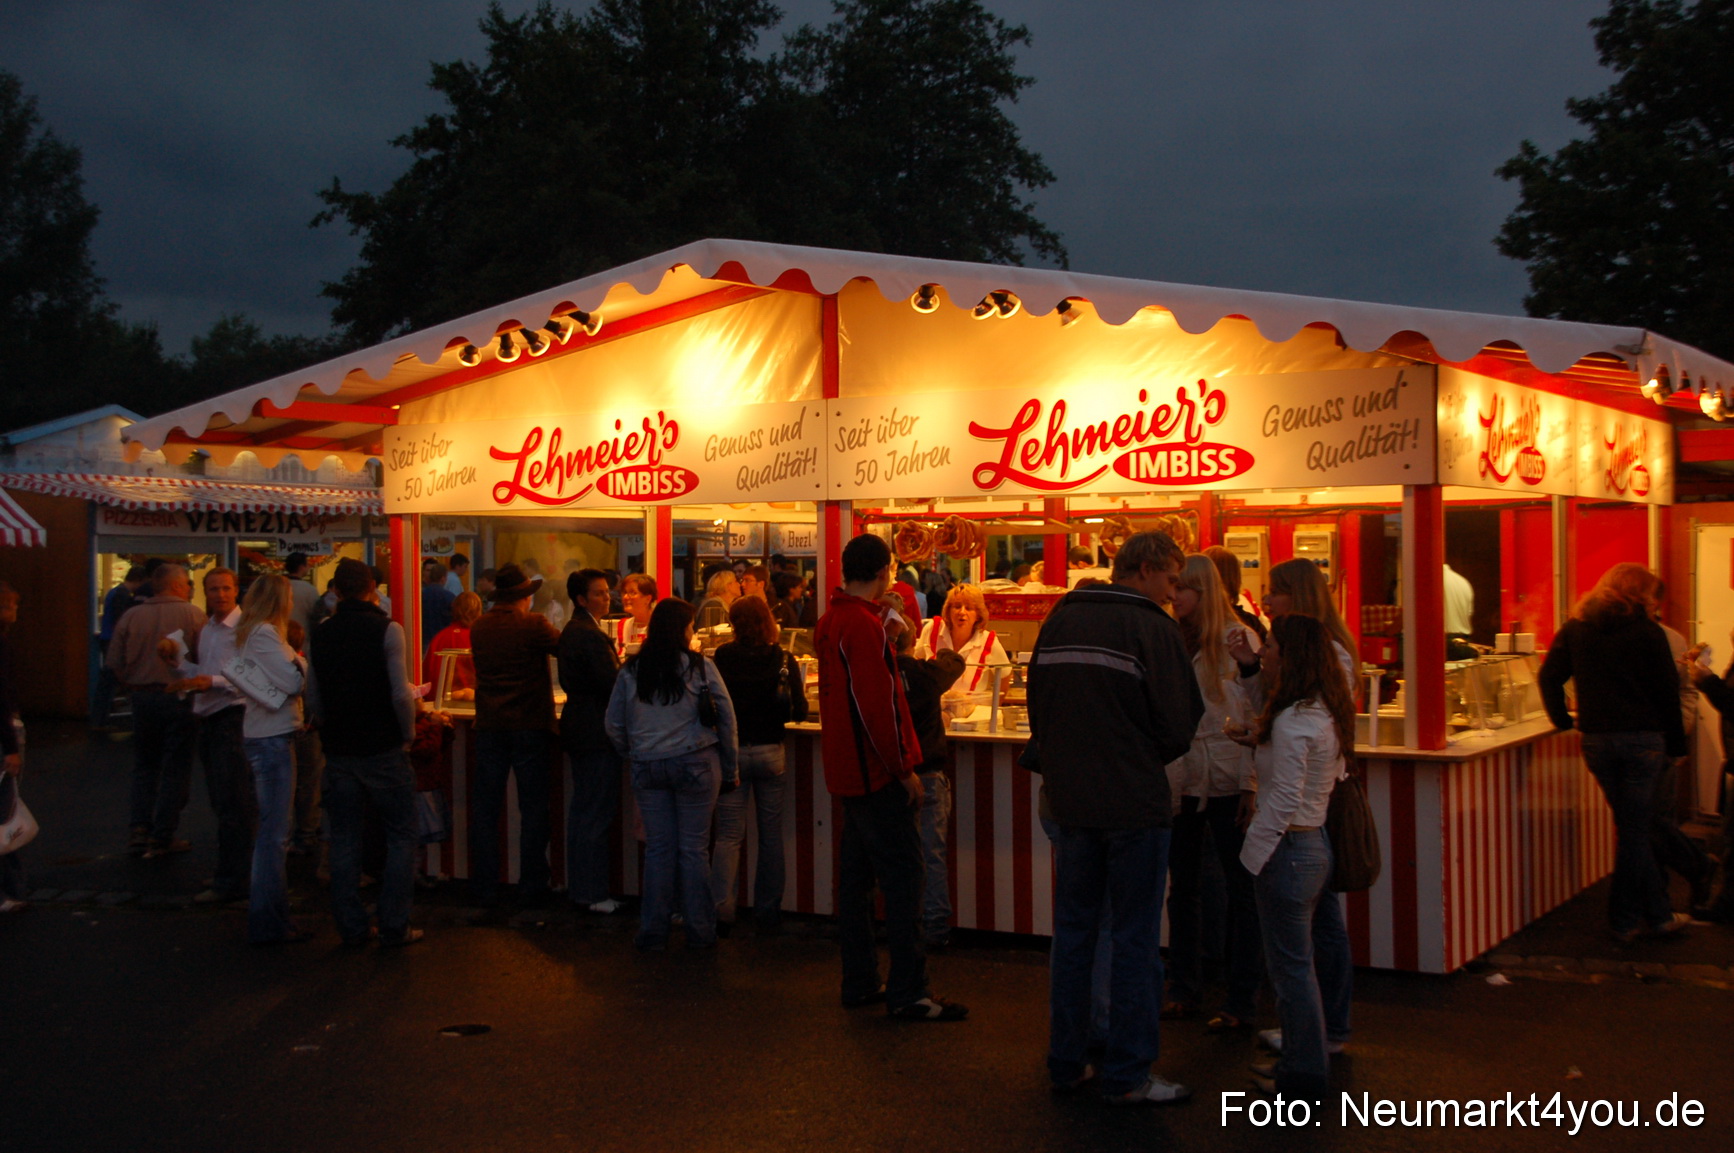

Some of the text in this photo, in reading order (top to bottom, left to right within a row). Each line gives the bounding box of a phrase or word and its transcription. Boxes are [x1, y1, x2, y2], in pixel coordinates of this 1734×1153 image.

[1263, 396, 1343, 438] Genuss
[1354, 371, 1406, 415] und
[389, 432, 454, 471] Seit über
[705, 406, 807, 462] Genuss und
[836, 405, 920, 453] Seit über
[968, 378, 1227, 490] Lehmeier's
[1306, 418, 1419, 471] Qualität!
[404, 461, 477, 500] 50 Jahren
[489, 410, 679, 506] Lehmeier's
[736, 446, 818, 492] Qualität!
[854, 440, 951, 485] 50 Jahren
[1129, 447, 1238, 479] IMBISS
[607, 469, 687, 496] IMBISS
[104, 510, 179, 527] PIZZERIA
[186, 510, 305, 533] VENEZIA
[788, 530, 812, 548] Brezl
[279, 538, 319, 553] Pommes
